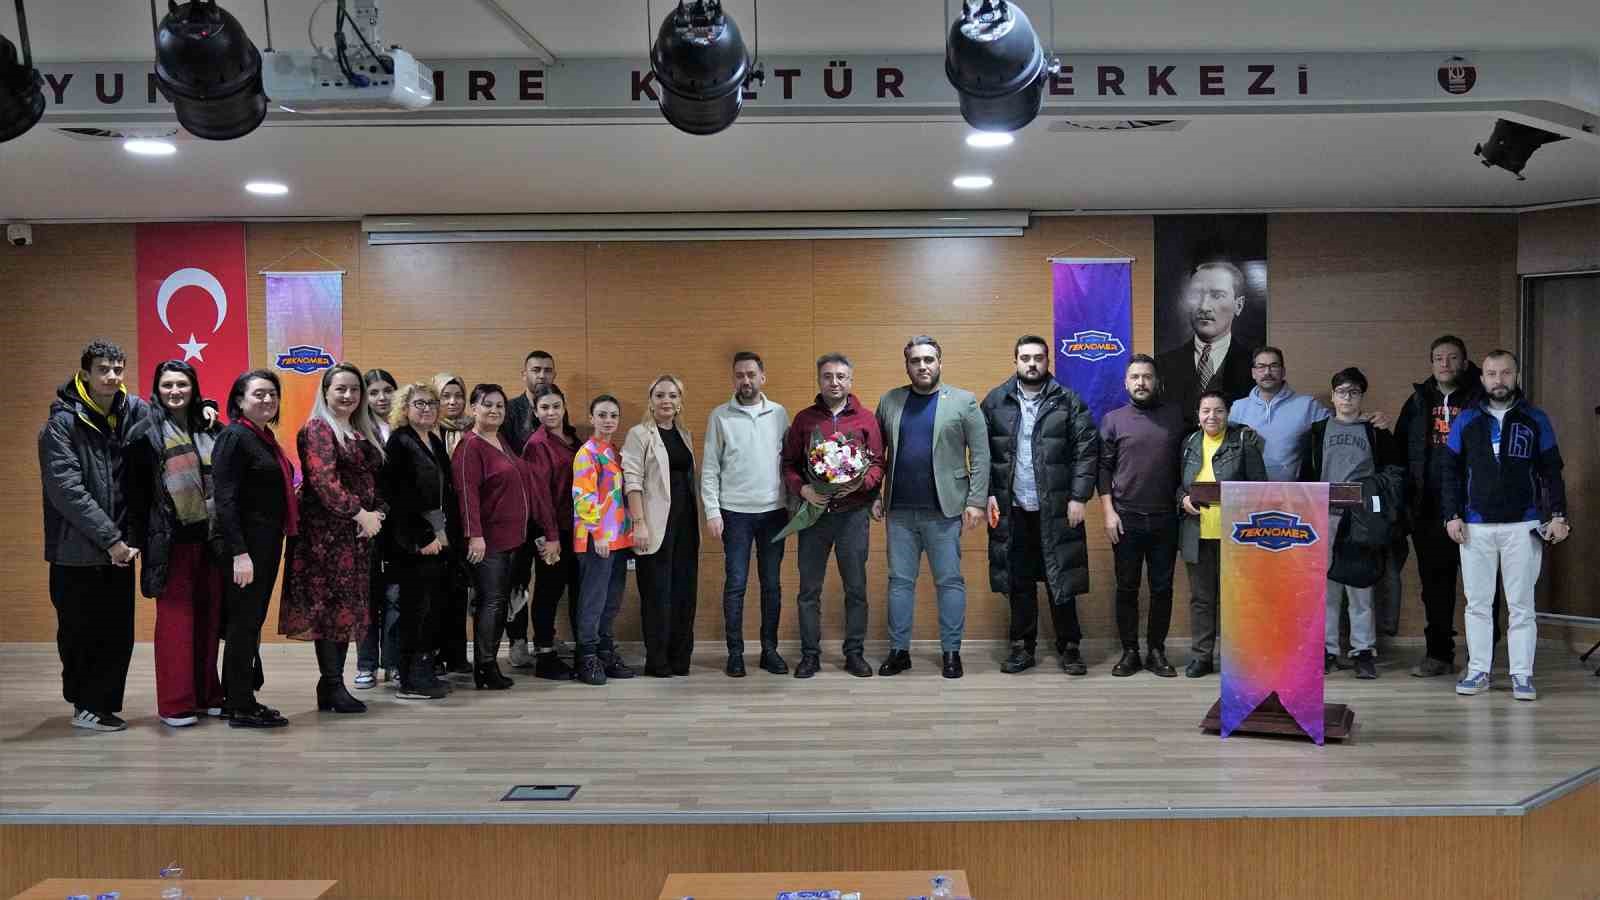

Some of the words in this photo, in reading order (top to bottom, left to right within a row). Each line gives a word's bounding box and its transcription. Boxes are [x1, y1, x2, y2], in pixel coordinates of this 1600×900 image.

[631, 60, 905, 101] KTÜR
[1048, 64, 1309, 96] ERKEZİ
[1068, 343, 1118, 353] TEKNOMER
[1239, 527, 1310, 540] TEKNOMER
